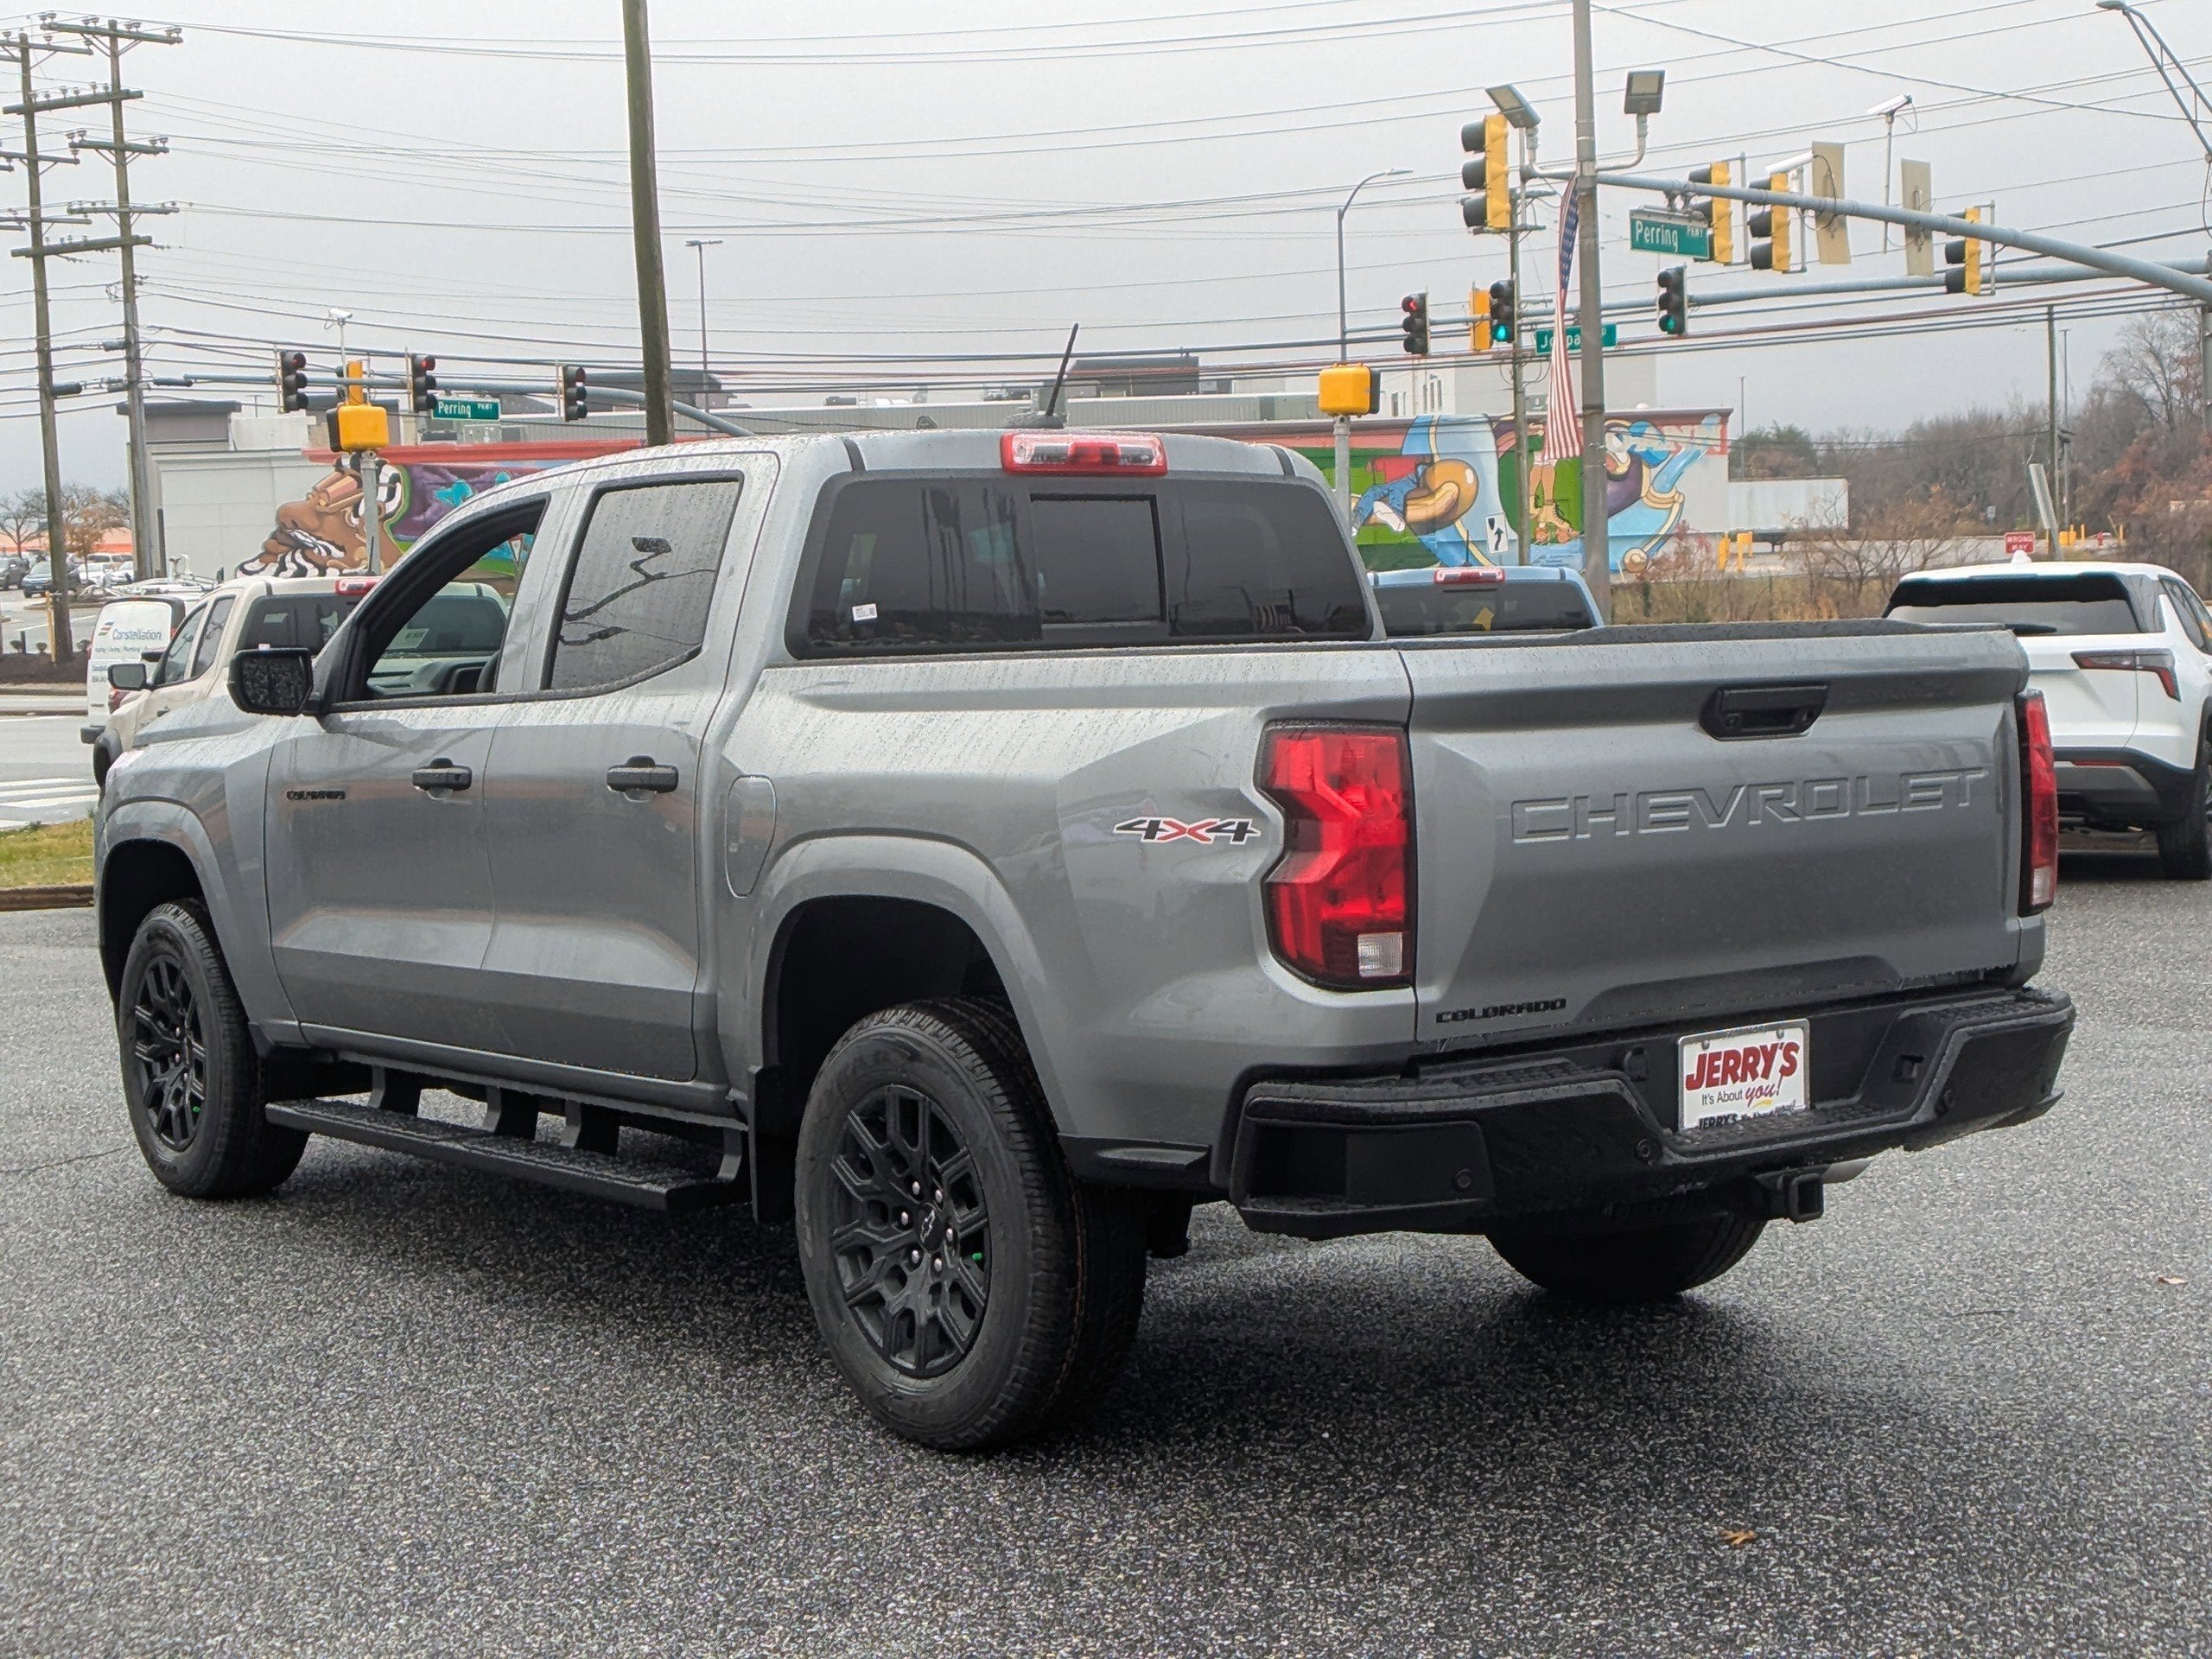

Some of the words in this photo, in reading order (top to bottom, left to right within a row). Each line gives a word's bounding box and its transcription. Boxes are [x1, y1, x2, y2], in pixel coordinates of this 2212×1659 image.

[1636, 219, 1678, 253] Perring
[438, 401, 471, 418] Perring
[112, 629, 162, 640] Constellation
[1511, 766, 1988, 843] CHEVROLET
[1436, 998, 1567, 1023] COLORADO
[1685, 1041, 1801, 1091] JERRY'S
[1701, 1093, 1715, 1106] It's
[1717, 1089, 1744, 1103] About
[1745, 1074, 1783, 1108] you!
